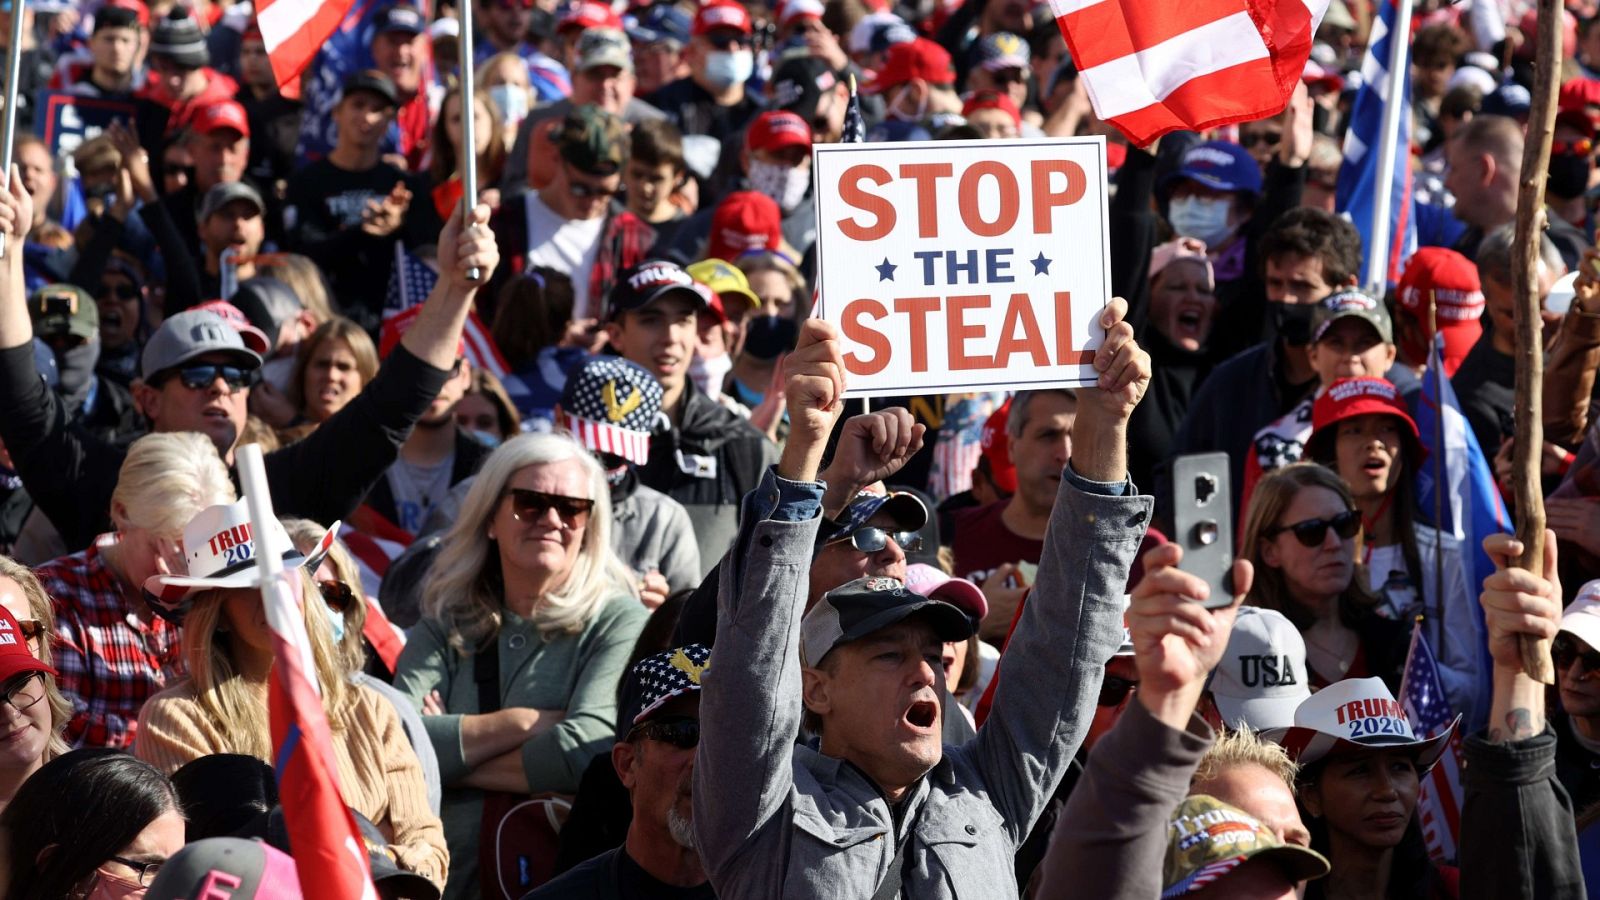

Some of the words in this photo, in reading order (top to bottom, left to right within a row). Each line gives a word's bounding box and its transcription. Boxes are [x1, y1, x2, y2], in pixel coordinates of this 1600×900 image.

[836, 159, 1087, 242] STOP
[914, 248, 1015, 286] THE
[840, 291, 1096, 376] STEAL
[208, 521, 257, 556] TRU
[1239, 655, 1297, 687] USA
[1349, 717, 1405, 737] 2020
[1212, 830, 1256, 846] 2020
